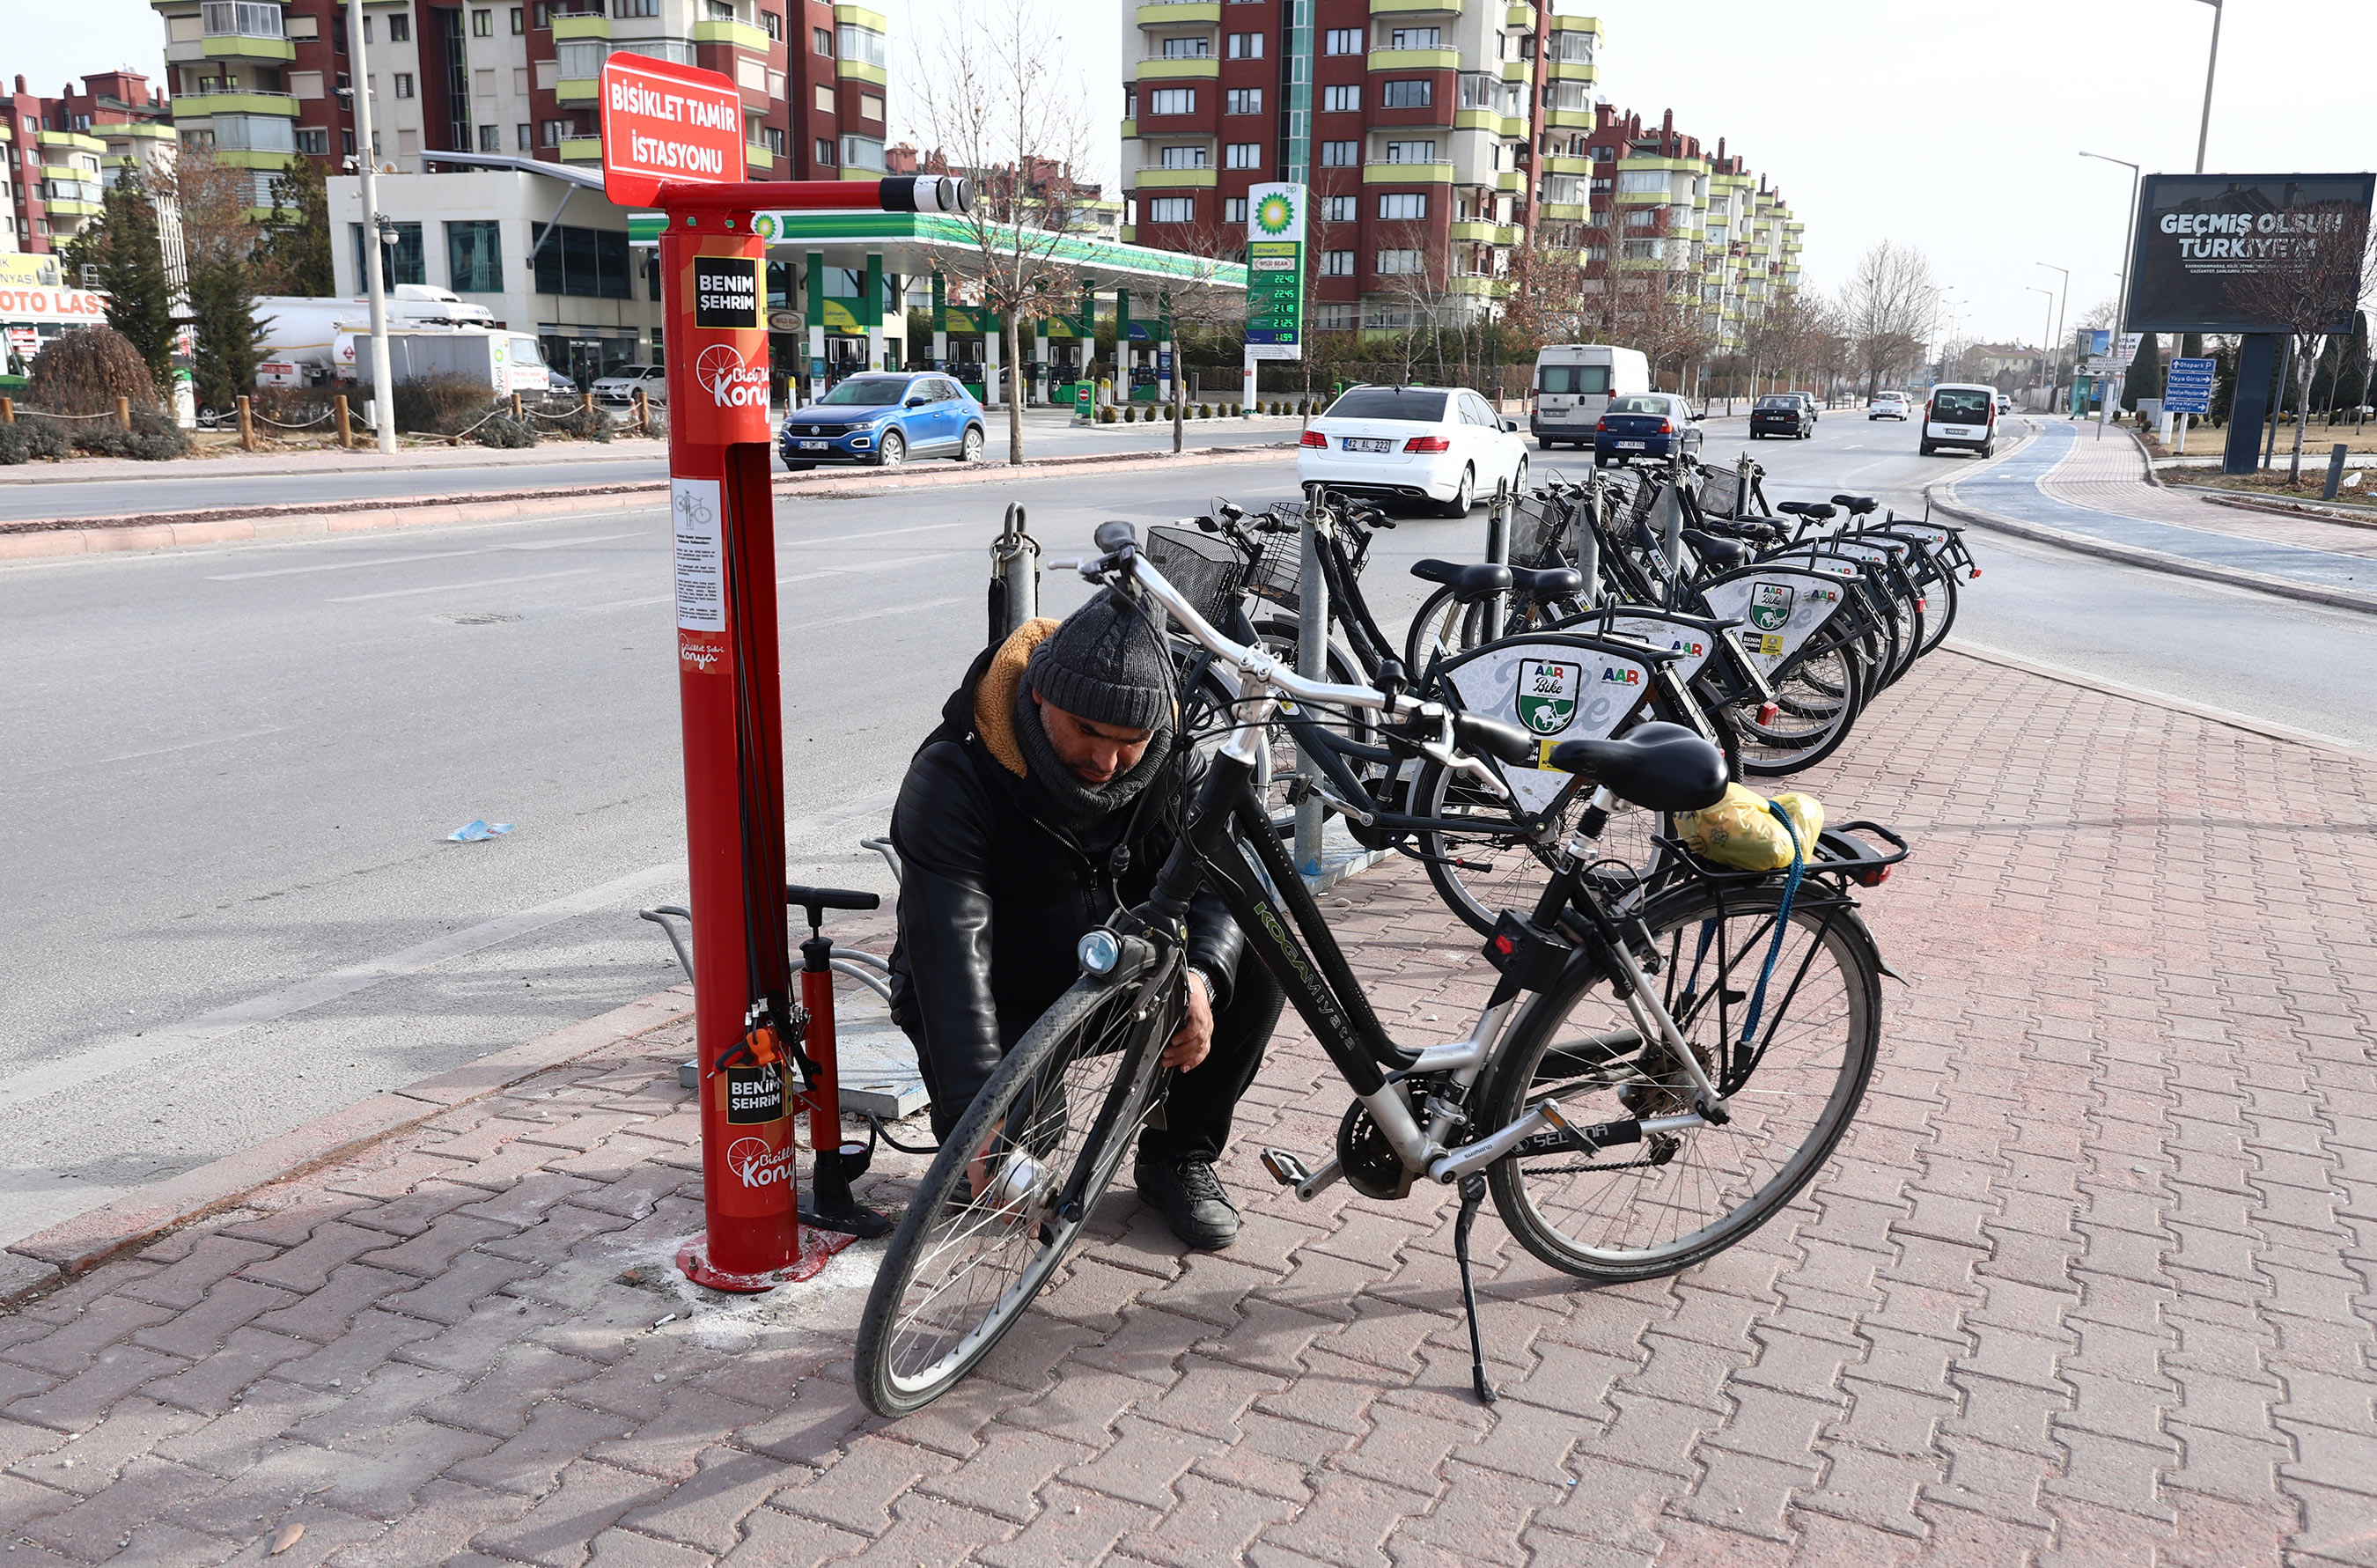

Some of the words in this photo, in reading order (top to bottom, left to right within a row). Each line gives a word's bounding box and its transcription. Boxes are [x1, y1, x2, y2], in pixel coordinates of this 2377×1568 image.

[611, 78, 685, 122] BİSİKLET
[687, 99, 736, 132] TAMİR
[631, 129, 723, 174] İSTASYONU
[2160, 214, 2253, 237] GEÇMİŞ
[2256, 214, 2344, 235] OLSUN
[699, 275, 754, 293] BENİM
[700, 294, 754, 311] ŞEHRİM
[714, 373, 770, 424] Kony
[1361, 440, 1370, 449] AL
[1375, 441, 1389, 450] 222
[1763, 586, 1782, 596] AAR
[1811, 589, 1836, 602] AAR
[1762, 594, 1782, 606] Bike
[1671, 640, 1703, 657] AAR
[1534, 665, 1564, 680] AAR
[1602, 667, 1639, 686] AAR
[1533, 676, 1564, 695] Bike
[732, 1093, 781, 1110] ŞEHRİM
[743, 1159, 795, 1191] Kony
